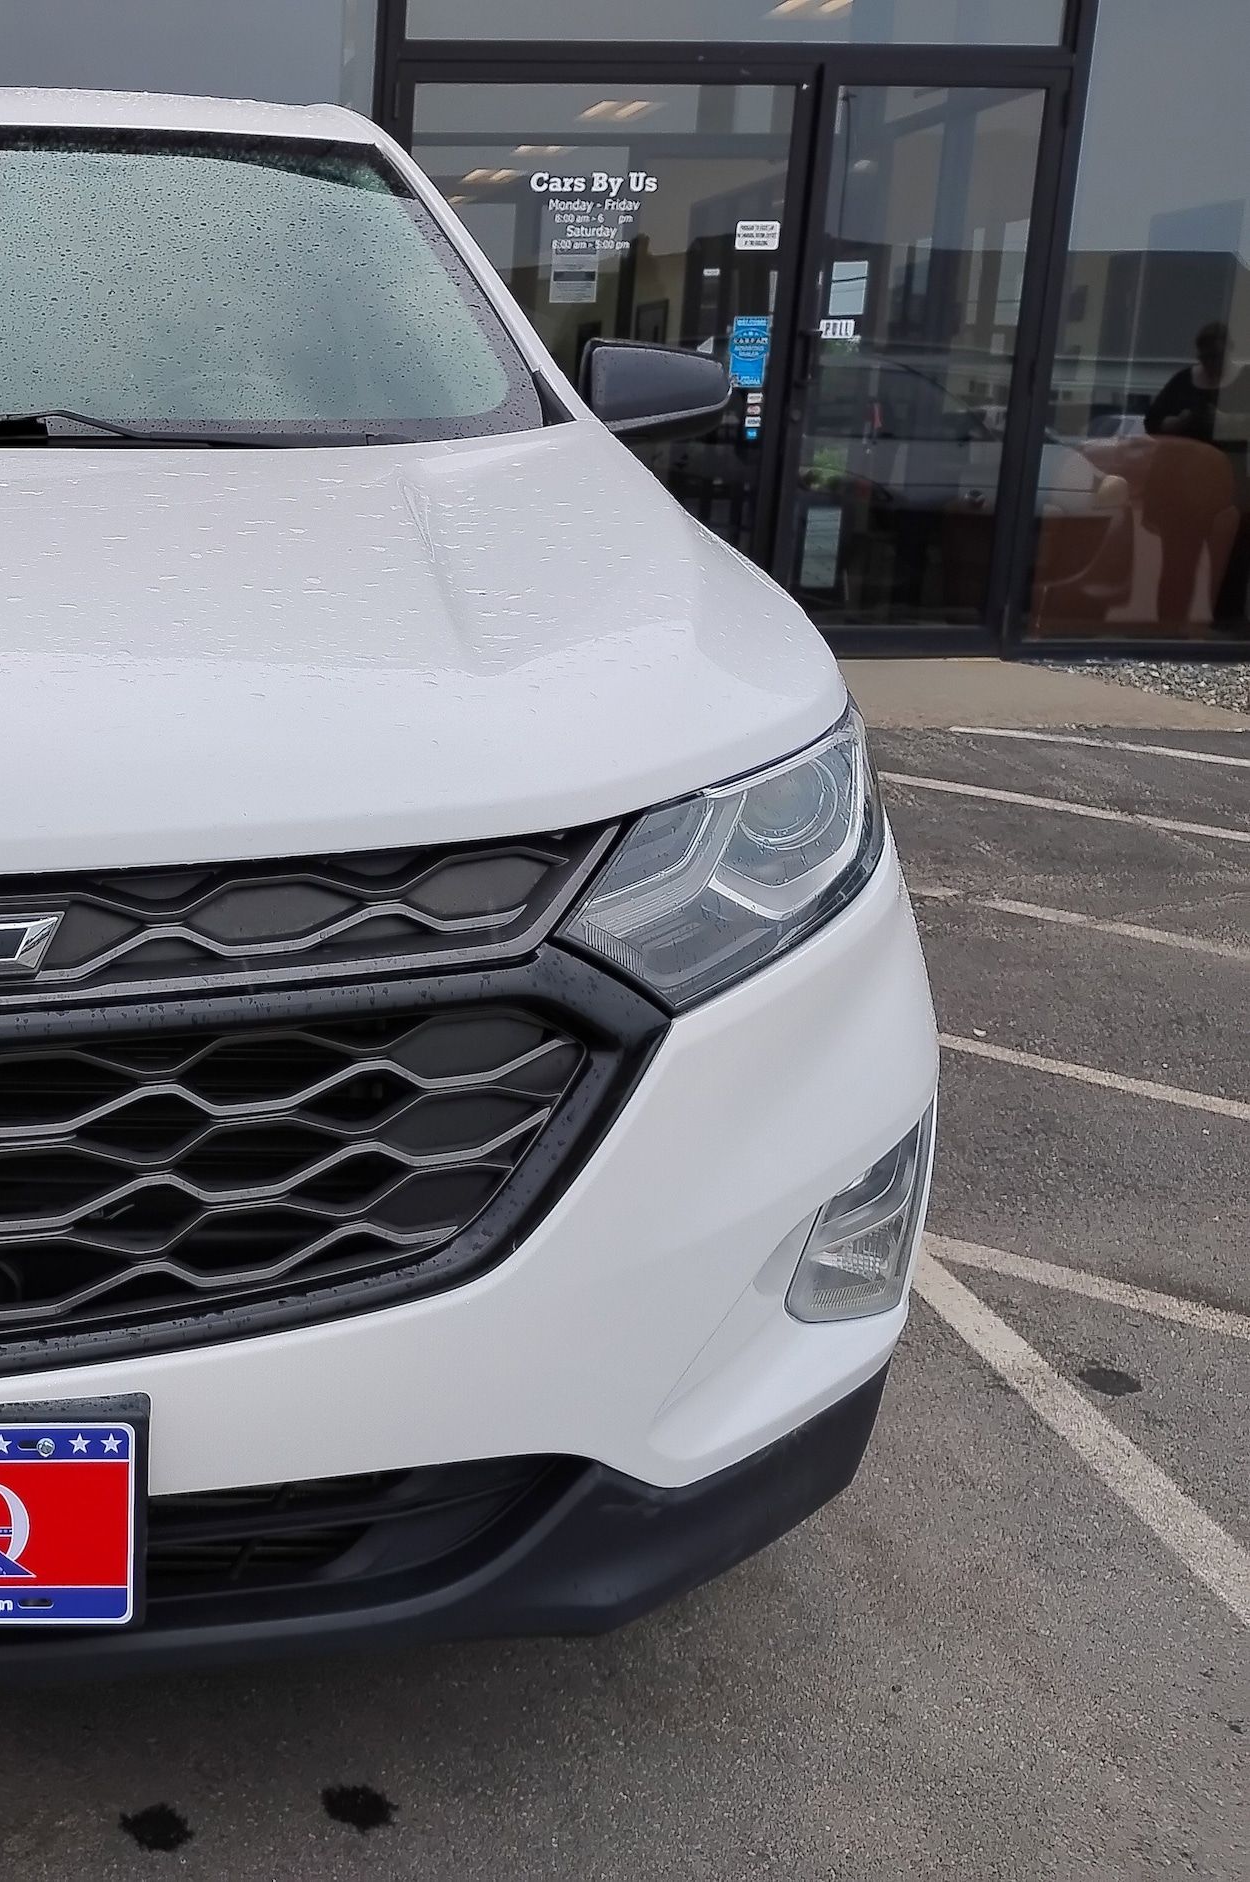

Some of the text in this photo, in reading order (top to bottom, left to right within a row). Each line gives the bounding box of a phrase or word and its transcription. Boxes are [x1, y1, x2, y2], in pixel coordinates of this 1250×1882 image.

[530, 171, 658, 197] Cars By Us
[548, 198, 594, 213] Monday
[604, 198, 641, 211] Friday
[575, 214, 590, 223] am
[618, 214, 634, 225] pm
[566, 224, 618, 239] Saturday
[615, 240, 631, 250] pm
[823, 321, 852, 337] PULL
